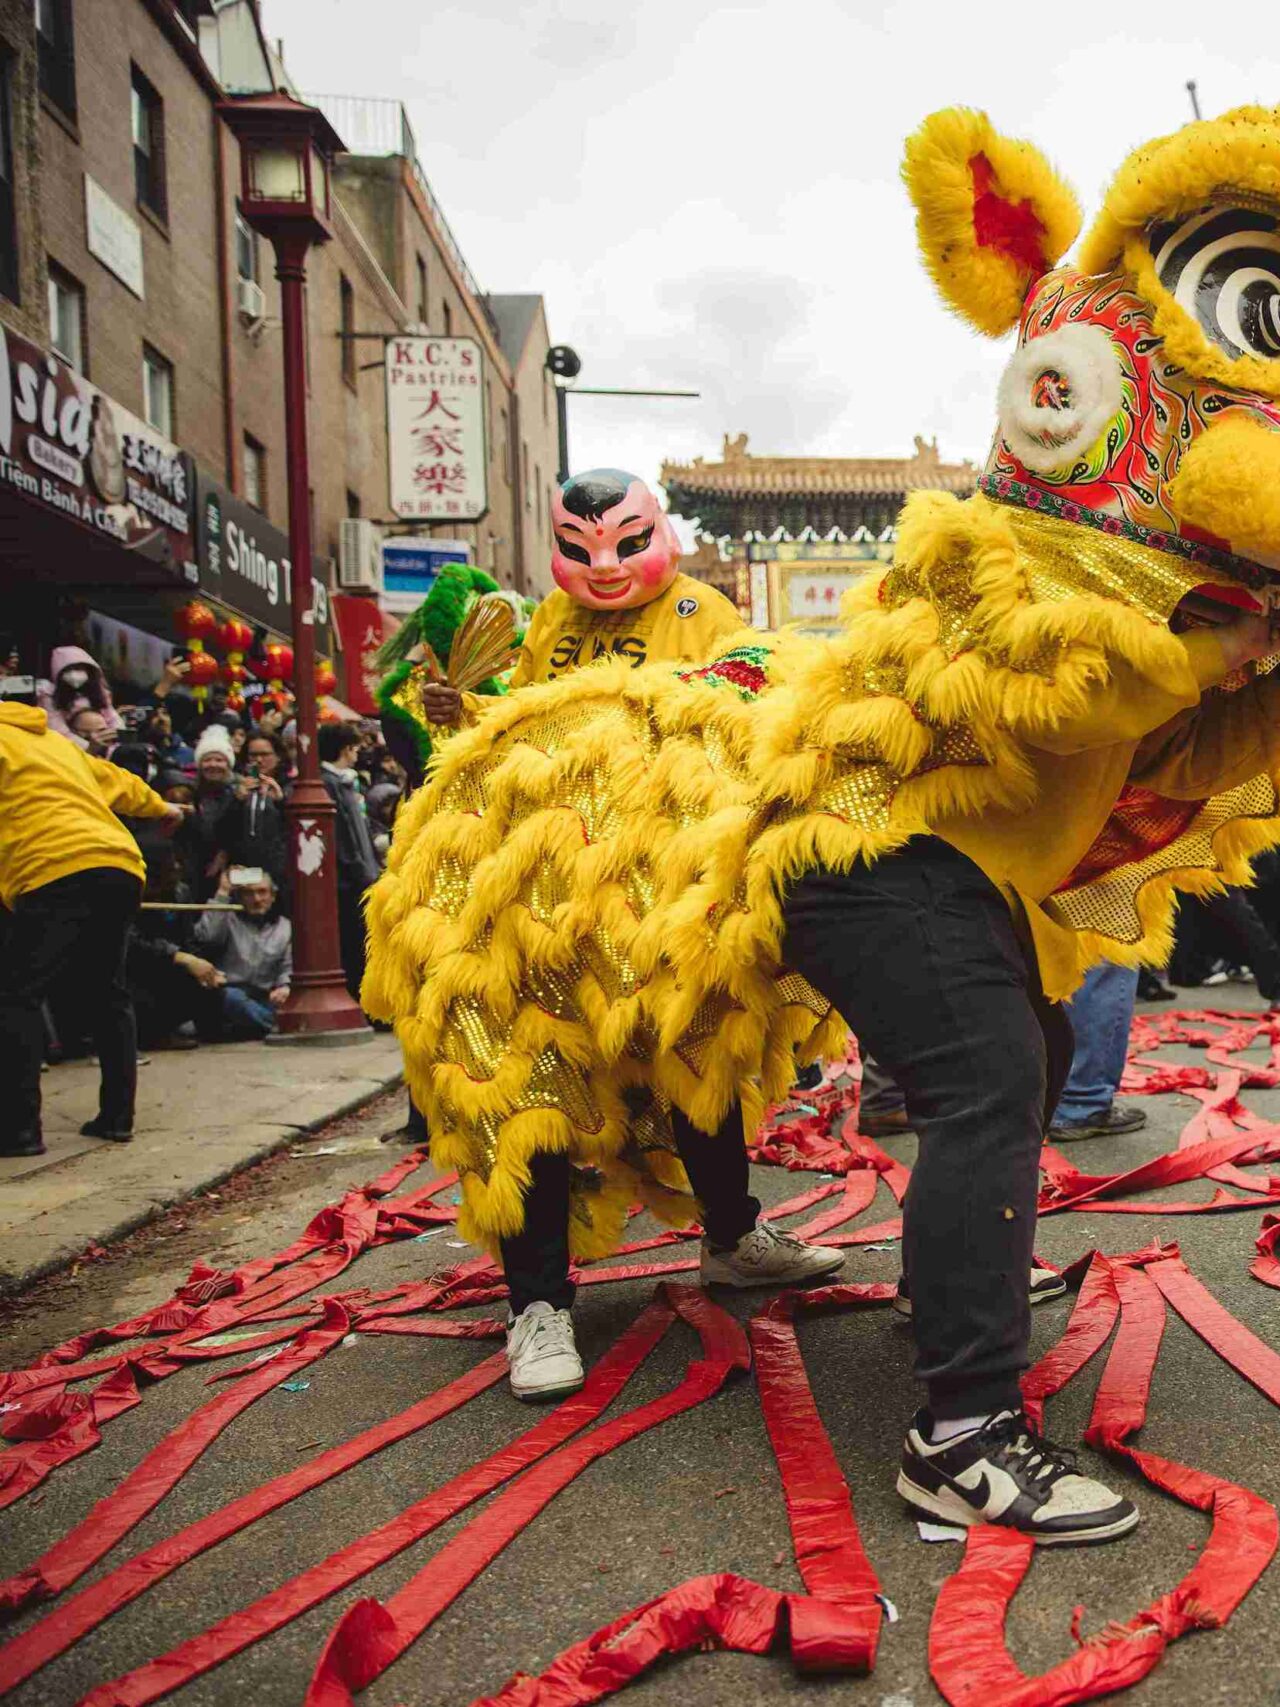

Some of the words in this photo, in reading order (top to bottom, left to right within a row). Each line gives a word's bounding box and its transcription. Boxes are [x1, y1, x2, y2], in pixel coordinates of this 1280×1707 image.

[395, 343, 472, 366] K.C.'s
[392, 369, 477, 385] Pastries
[408, 390, 466, 494] 大家樂
[226, 520, 278, 605] Shing
[549, 634, 647, 668] SUNS
